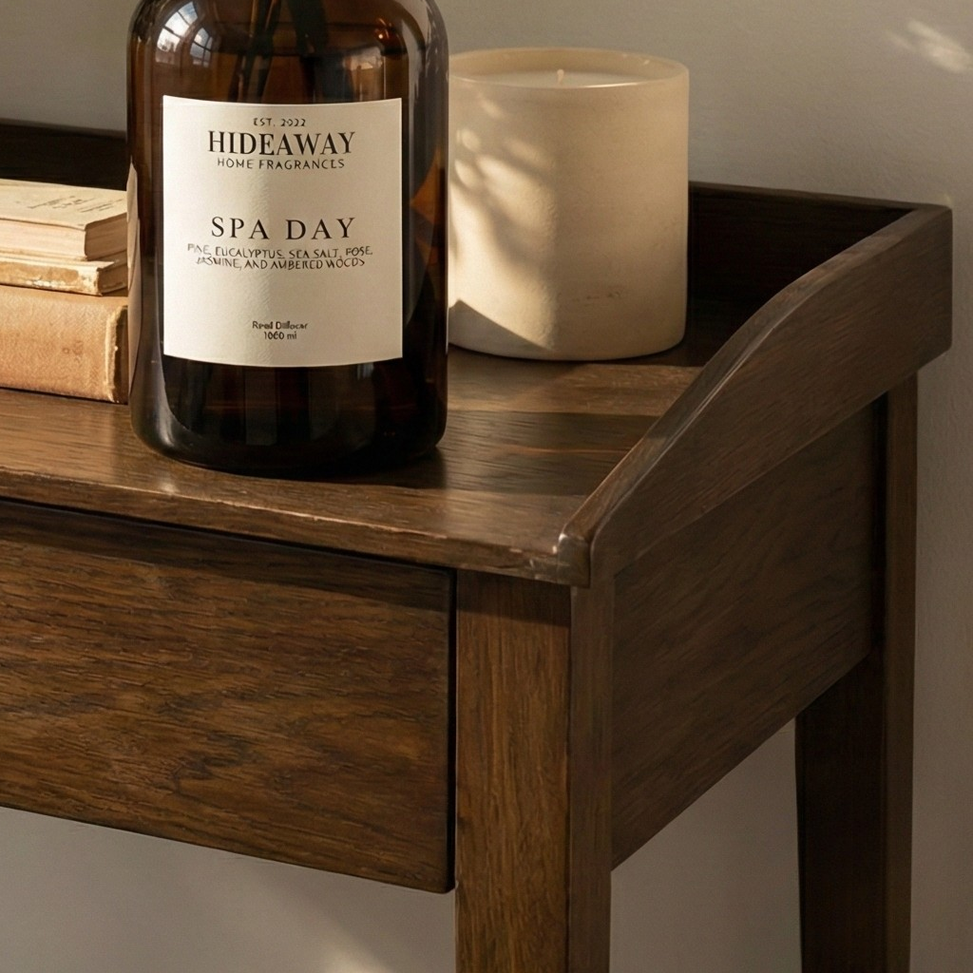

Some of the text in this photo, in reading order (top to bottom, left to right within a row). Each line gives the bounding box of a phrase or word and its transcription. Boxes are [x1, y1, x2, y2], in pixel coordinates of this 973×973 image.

[207, 130, 356, 156] HIDEAWAY
[217, 157, 346, 170] HOME FRAGRANCES
[211, 215, 356, 241] SPA DAY
